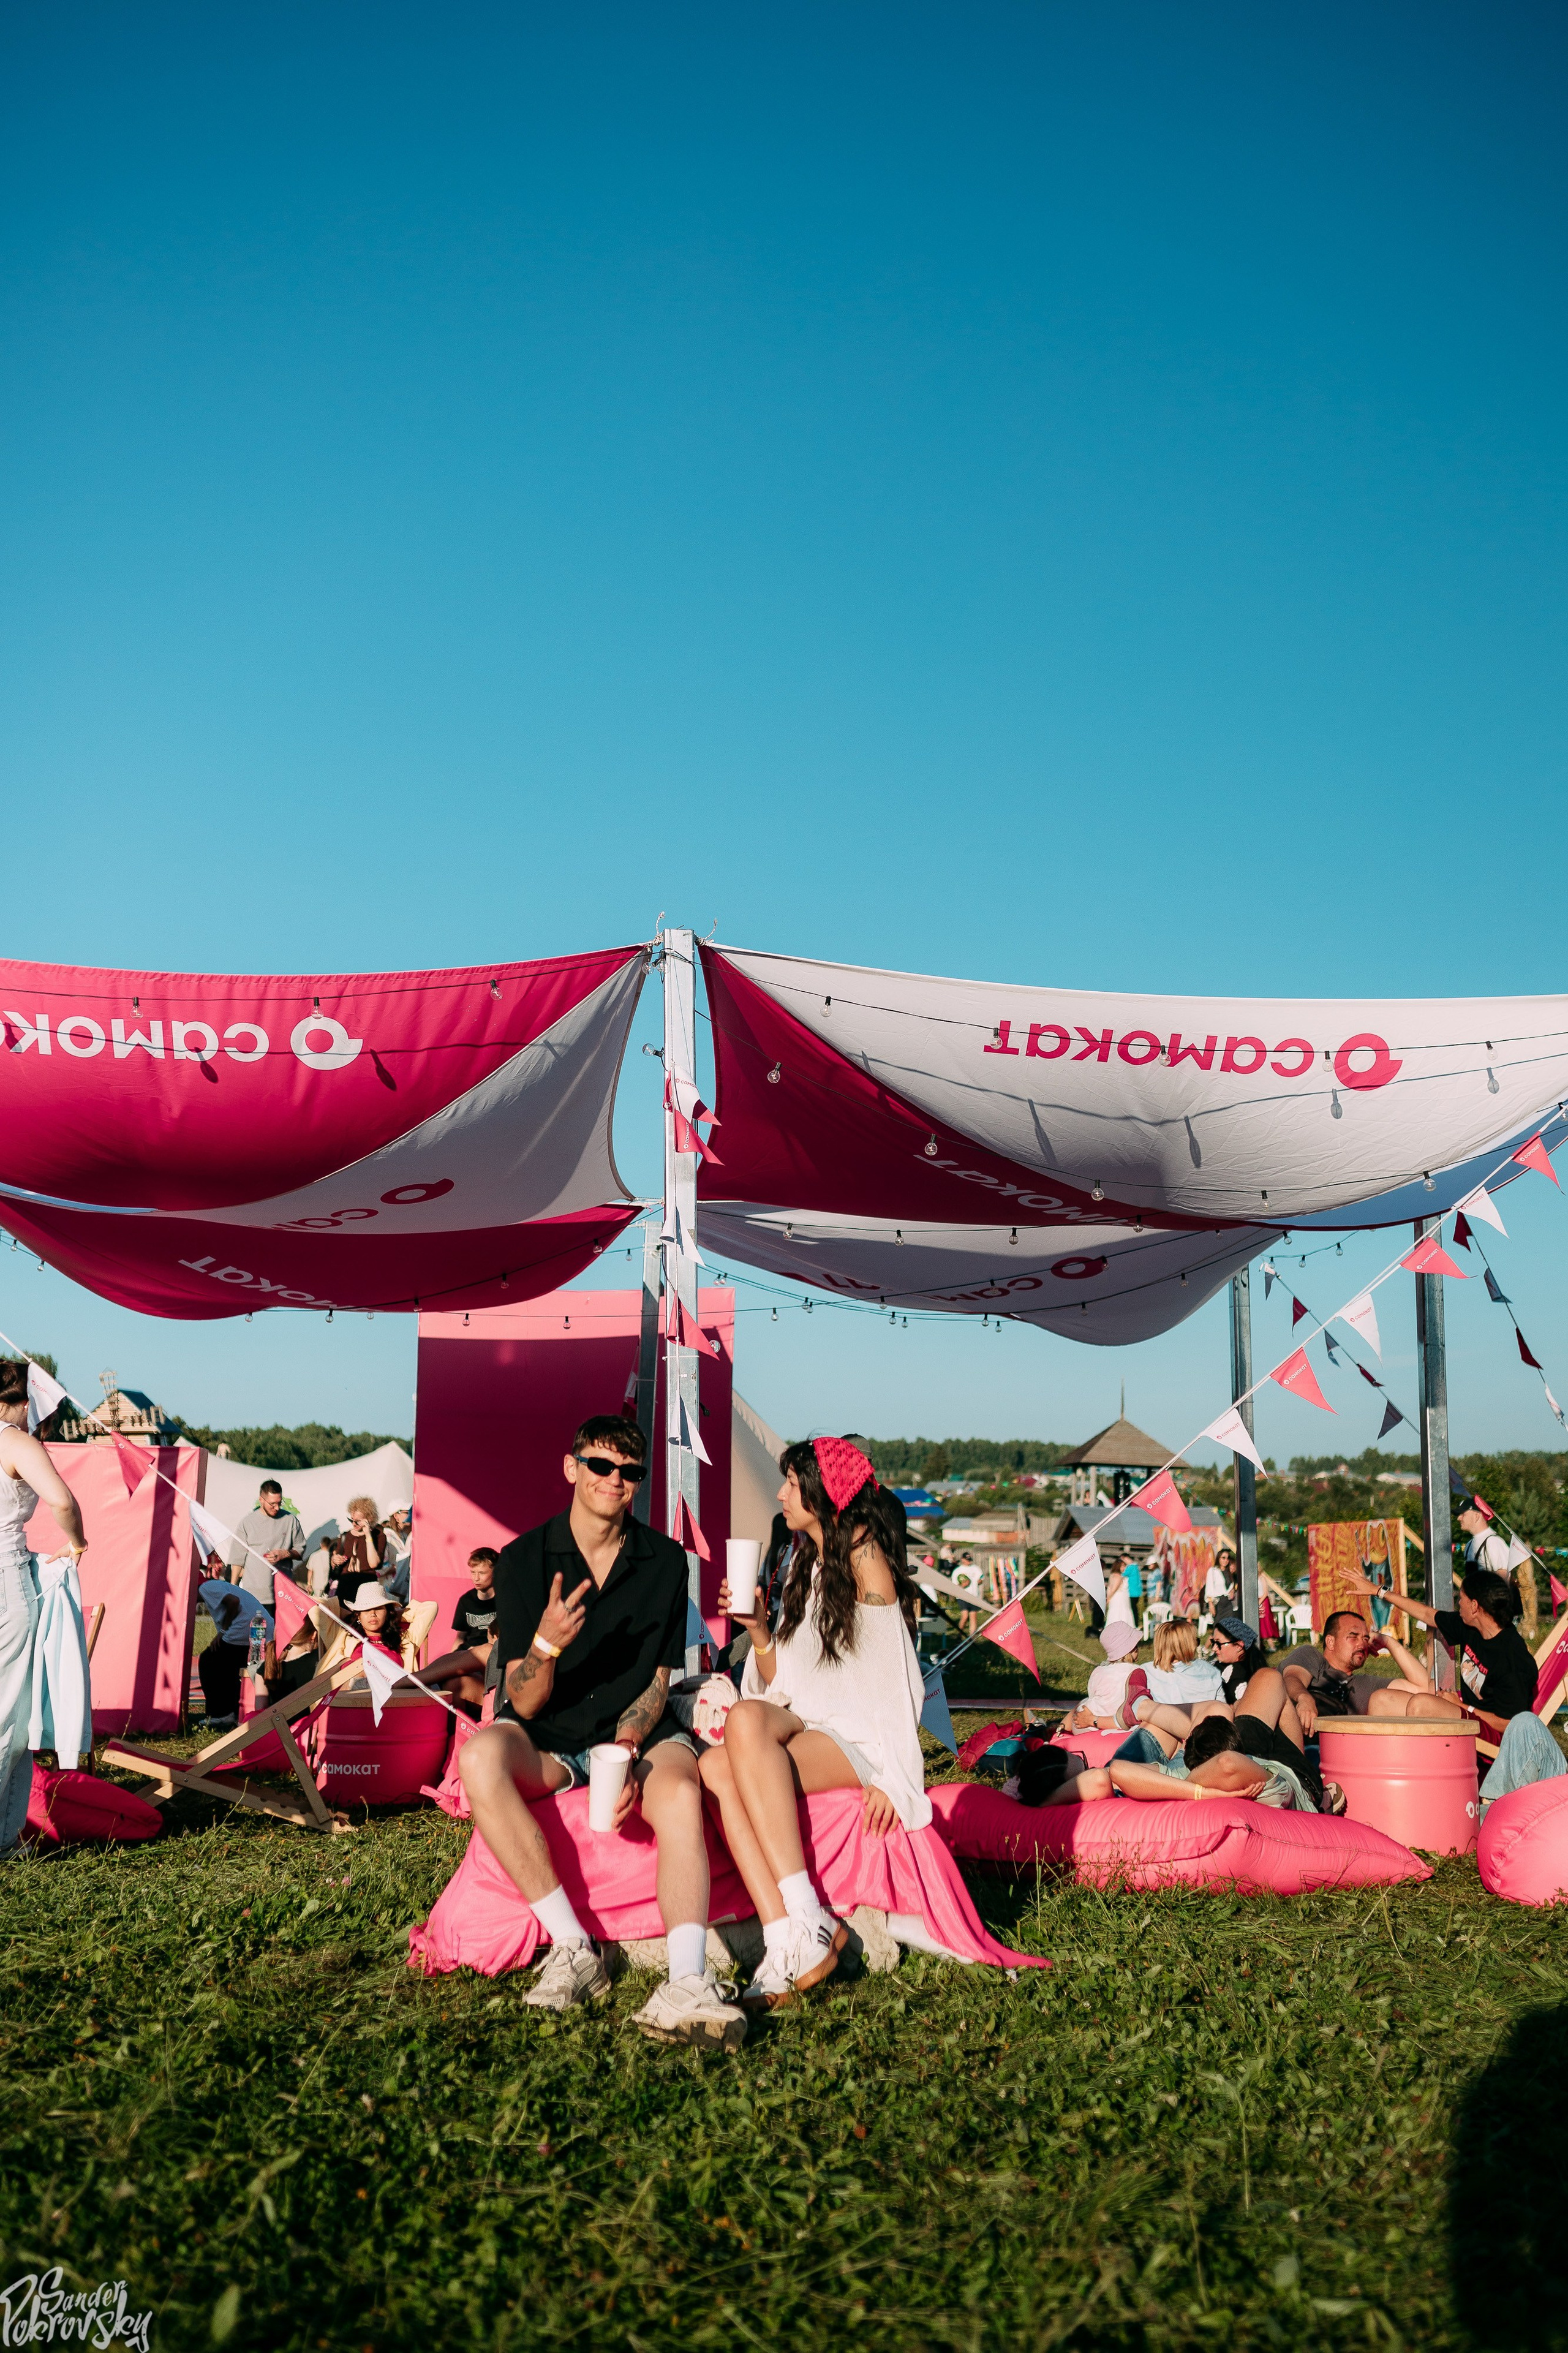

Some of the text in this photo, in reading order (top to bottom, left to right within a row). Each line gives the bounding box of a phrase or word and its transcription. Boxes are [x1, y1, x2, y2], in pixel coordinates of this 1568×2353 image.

[0, 1010, 270, 1062] самок
[983, 1020, 1314, 1078] самокат
[1524, 1143, 1541, 1158] самокат
[1466, 1194, 1485, 1207] самокат
[1421, 1248, 1439, 1266] самокат
[1354, 1307, 1373, 1320] самокат
[1289, 1364, 1308, 1381] самокат
[1221, 1422, 1240, 1437] самокат
[1152, 1486, 1173, 1505] самокат
[1076, 1553, 1096, 1571] самокат
[1003, 1618, 1023, 1637] самокат
[322, 1763, 380, 1775] самокат
